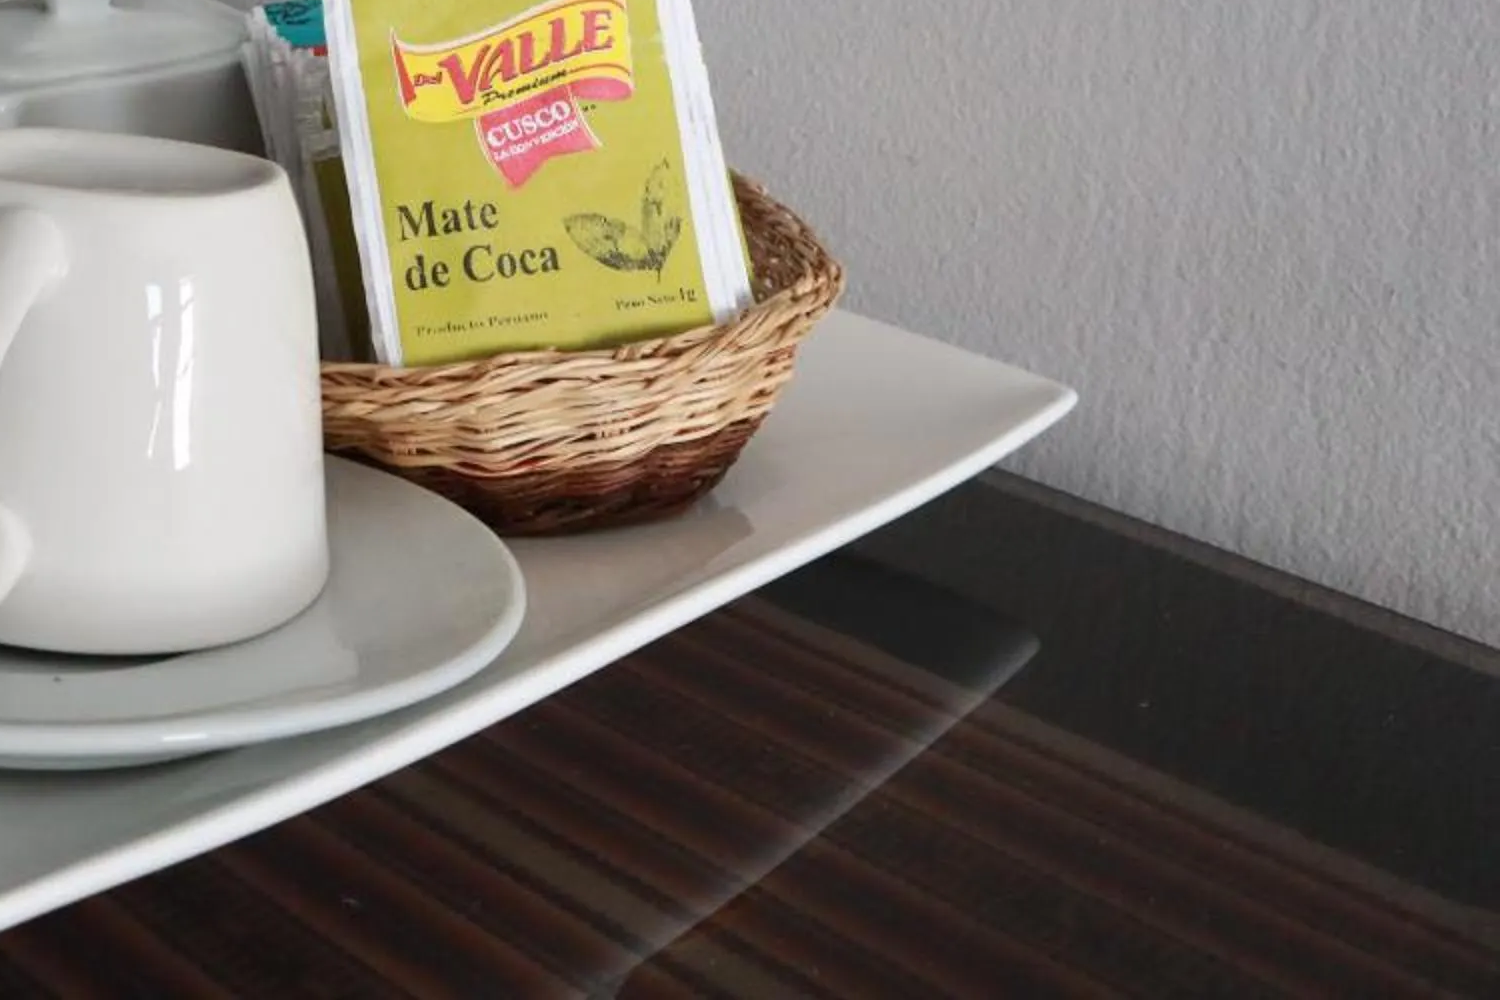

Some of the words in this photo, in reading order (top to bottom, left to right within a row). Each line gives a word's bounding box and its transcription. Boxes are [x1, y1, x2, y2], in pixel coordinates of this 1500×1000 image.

[437, 9, 614, 105] VALLE
[487, 100, 571, 147] CUSCO
[396, 199, 499, 241] Mate
[404, 253, 451, 291] de
[463, 244, 561, 283] Coca
